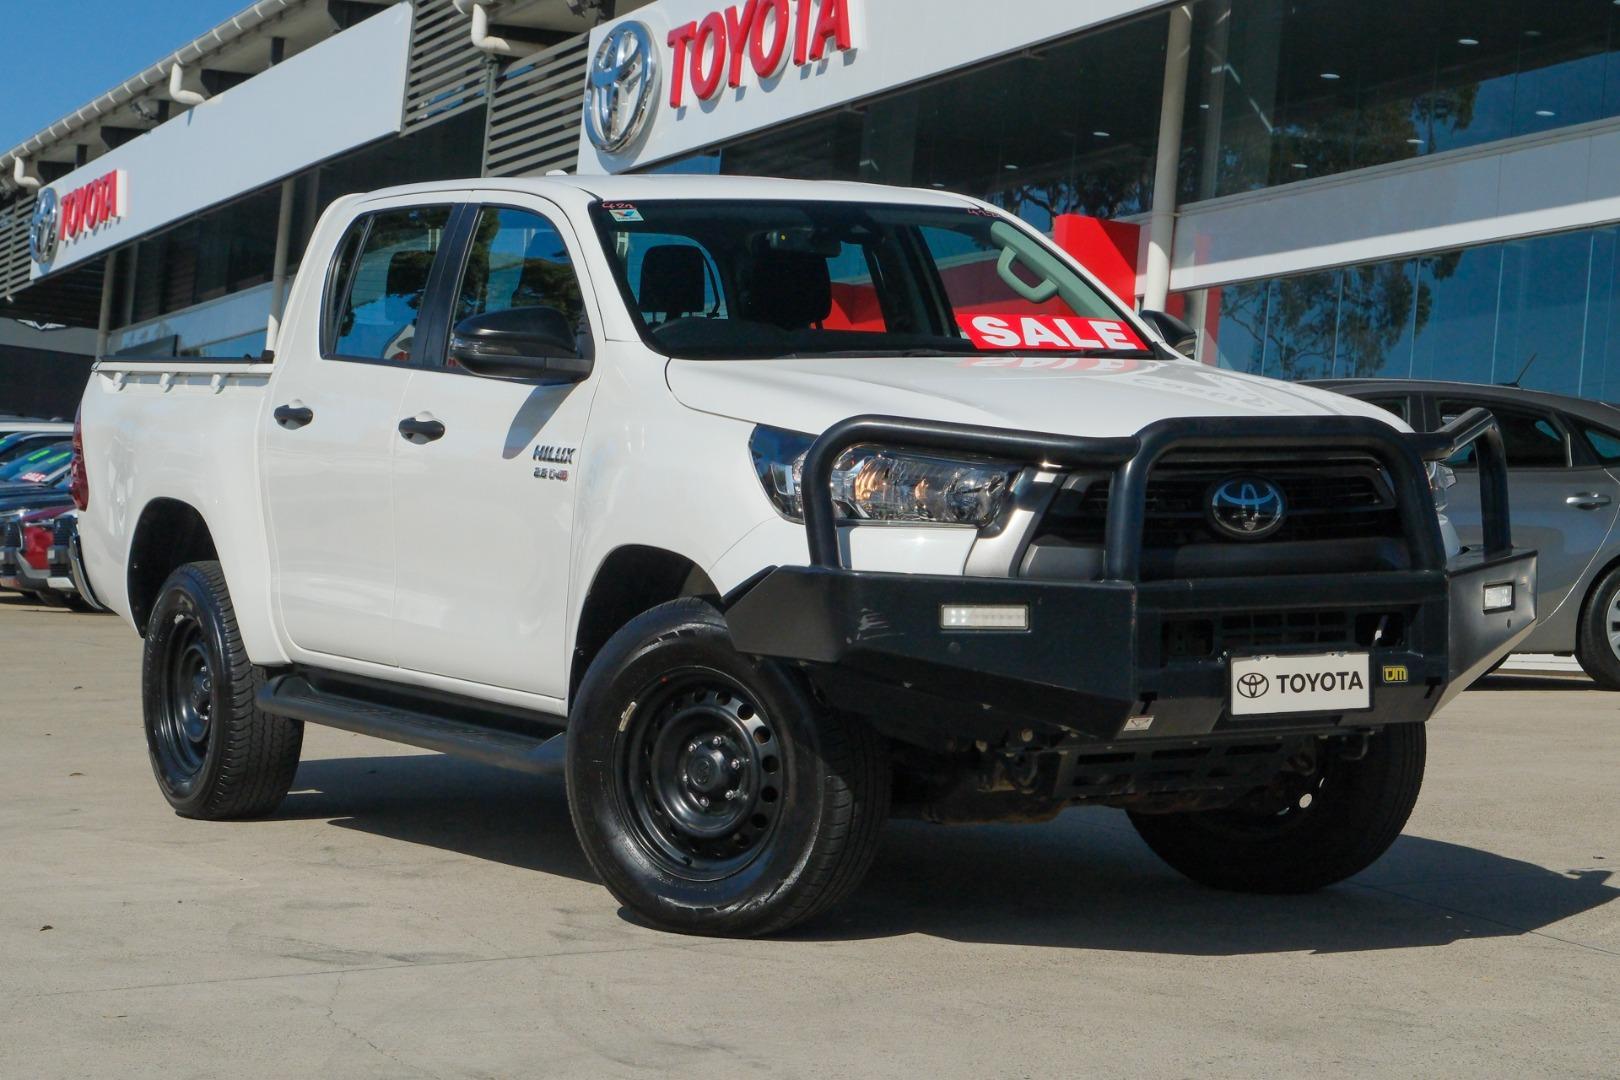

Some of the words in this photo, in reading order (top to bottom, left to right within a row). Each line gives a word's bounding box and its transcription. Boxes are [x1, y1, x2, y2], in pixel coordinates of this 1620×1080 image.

[667, 0, 850, 109] TOYOTA
[59, 169, 117, 241] TOYOTA
[971, 316, 1138, 350] SALE
[533, 445, 576, 464] HILUX
[1276, 671, 1364, 694] TOYOTA
